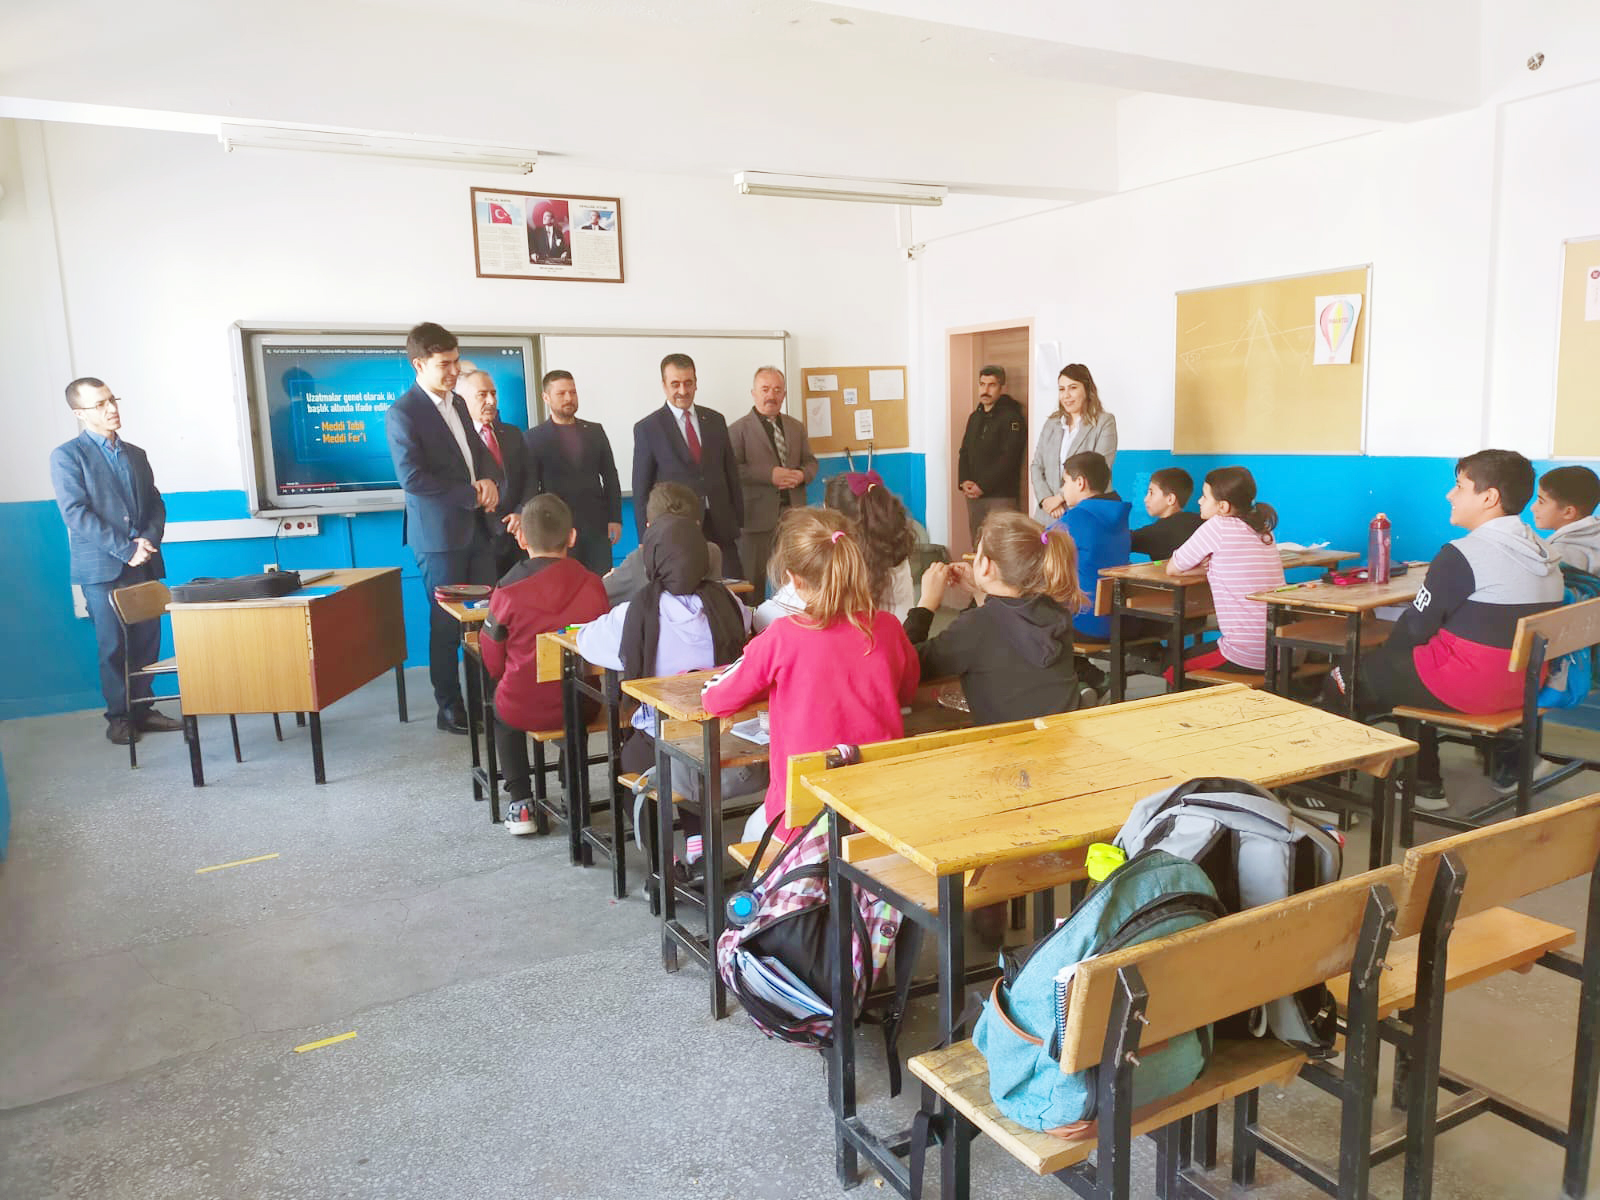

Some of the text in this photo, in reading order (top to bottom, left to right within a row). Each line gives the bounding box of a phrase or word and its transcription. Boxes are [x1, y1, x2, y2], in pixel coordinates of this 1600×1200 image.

[306, 391, 396, 404] Uzatmalar genel olarak iki
[321, 421, 345, 431] Meddi
[322, 433, 346, 443] Meddi
